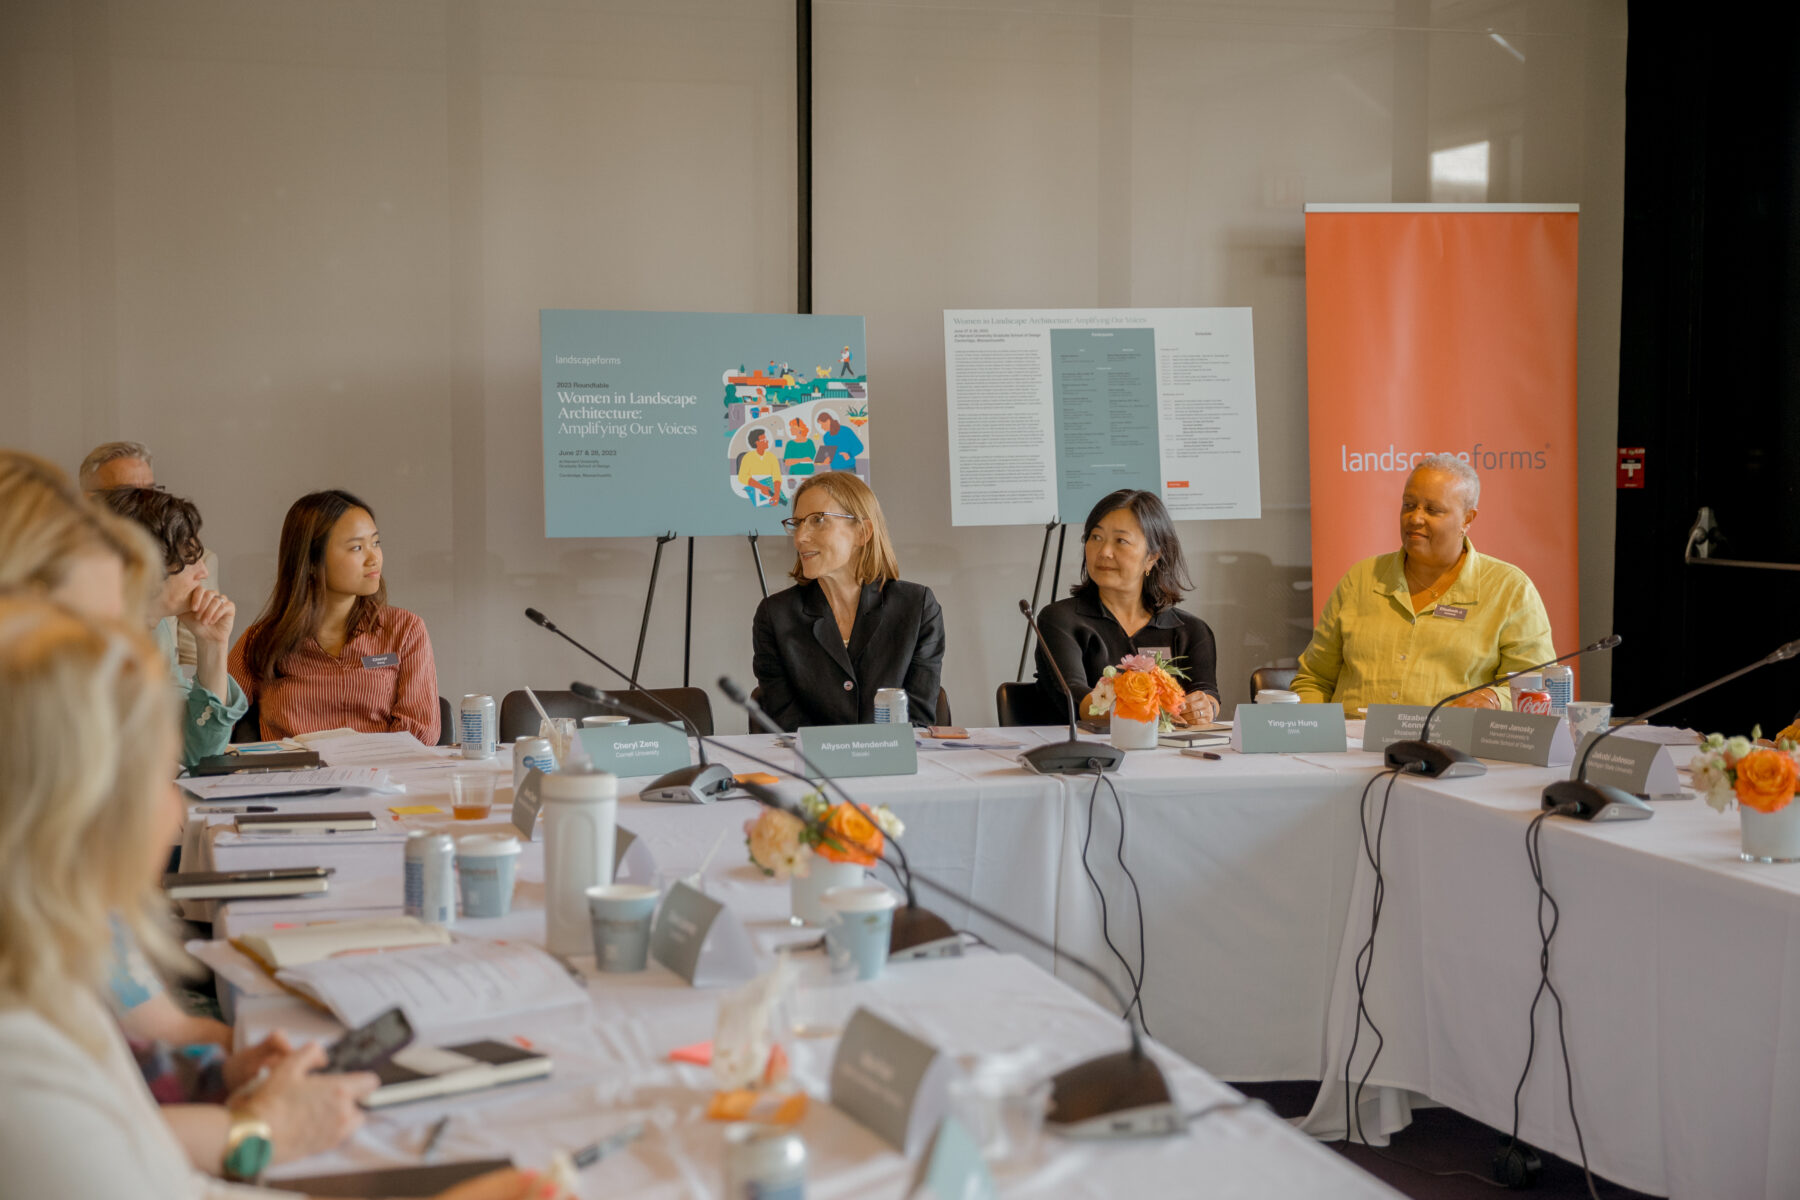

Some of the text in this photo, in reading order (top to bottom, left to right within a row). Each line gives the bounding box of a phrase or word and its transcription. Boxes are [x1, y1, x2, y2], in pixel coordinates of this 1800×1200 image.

[953, 317, 981, 325] Women
[991, 317, 1027, 328] Landscape
[555, 355, 621, 366] landscapeforms
[558, 391, 697, 408] Women in Landscape
[558, 407, 643, 419] Architecture:
[558, 421, 697, 438] Amplifying Our Voices
[1342, 443, 1546, 472] landsceforms
[1268, 719, 1318, 728] Ying-yu Hung
[1489, 721, 1535, 735] Karen Janosky
[613, 740, 660, 751] Cheryl Zeng
[821, 740, 899, 752] Allyson Mendenhall
